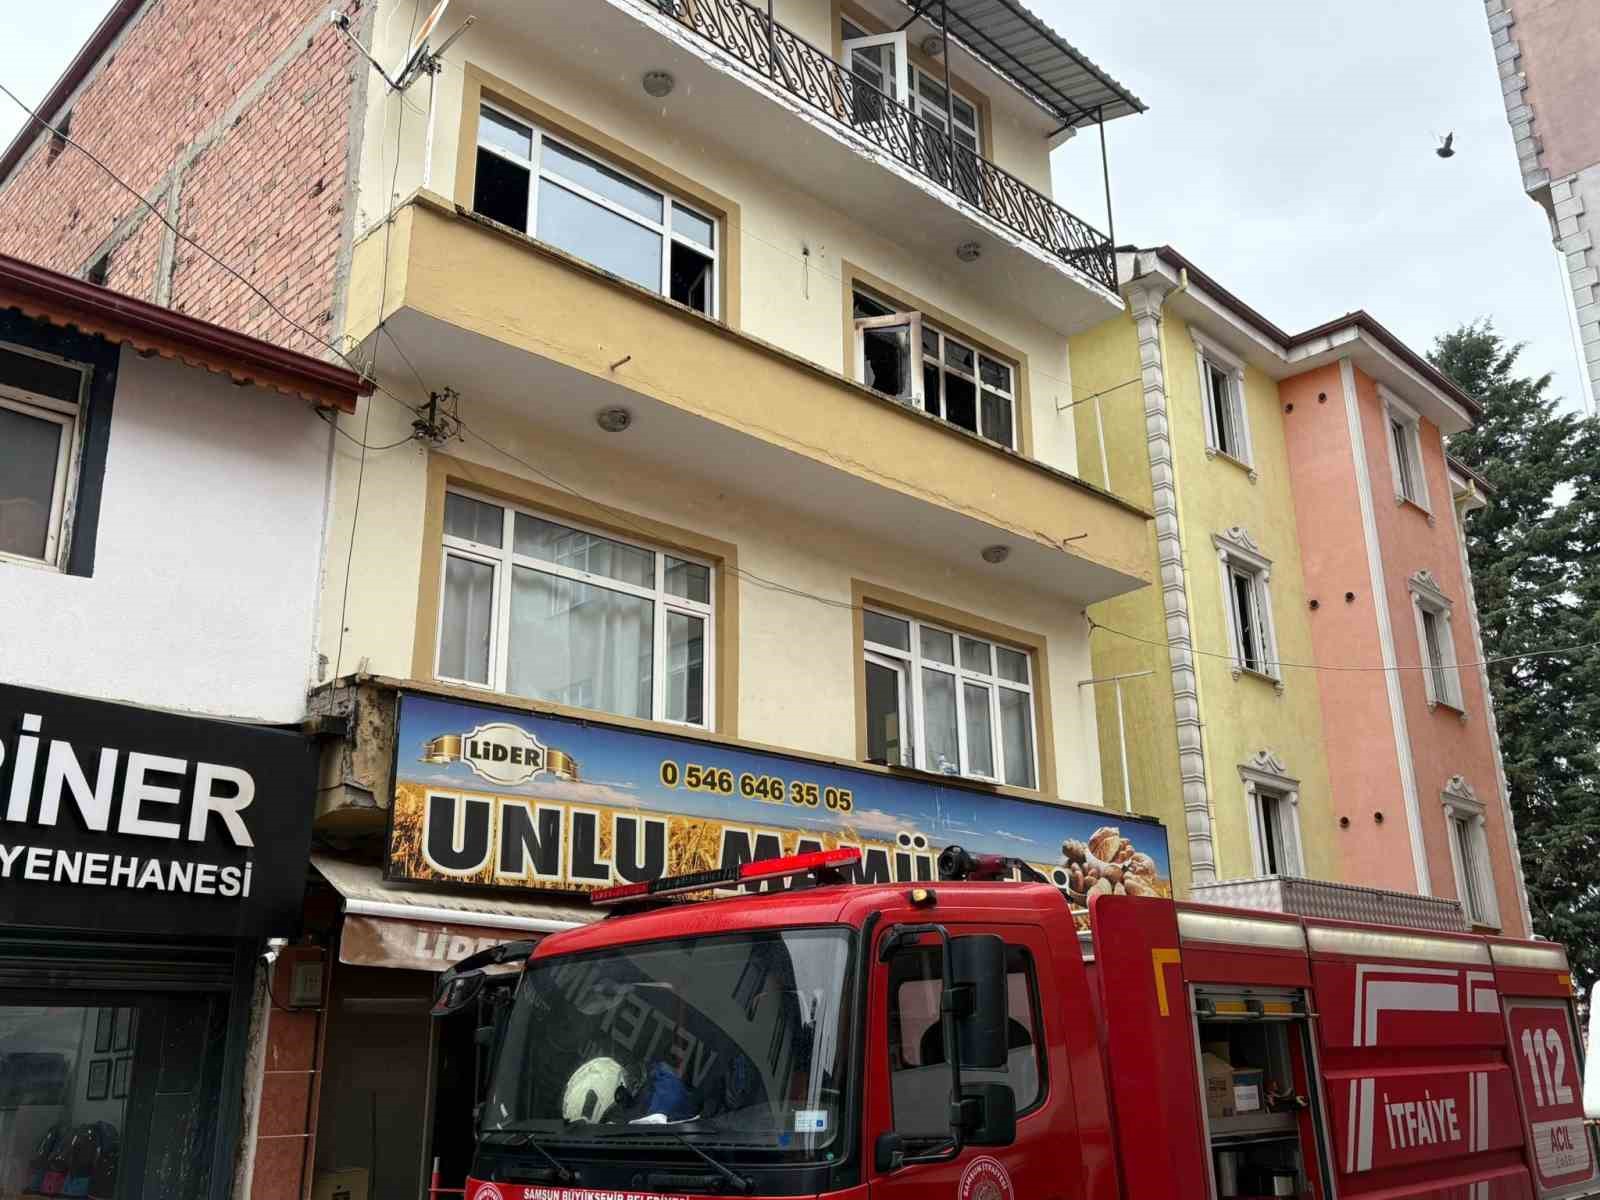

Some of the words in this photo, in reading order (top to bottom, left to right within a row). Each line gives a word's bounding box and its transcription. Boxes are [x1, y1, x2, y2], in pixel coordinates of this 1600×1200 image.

[0, 713, 256, 848] İNER
[662, 762, 678, 785] 0
[686, 766, 733, 793] 546
[740, 775, 784, 801] 646
[791, 783, 818, 807] 35
[825, 788, 852, 811] 05
[425, 793, 668, 884] UNLU
[1521, 1028, 1574, 1107] 112
[1383, 1089, 1461, 1149] İTFAİYE
